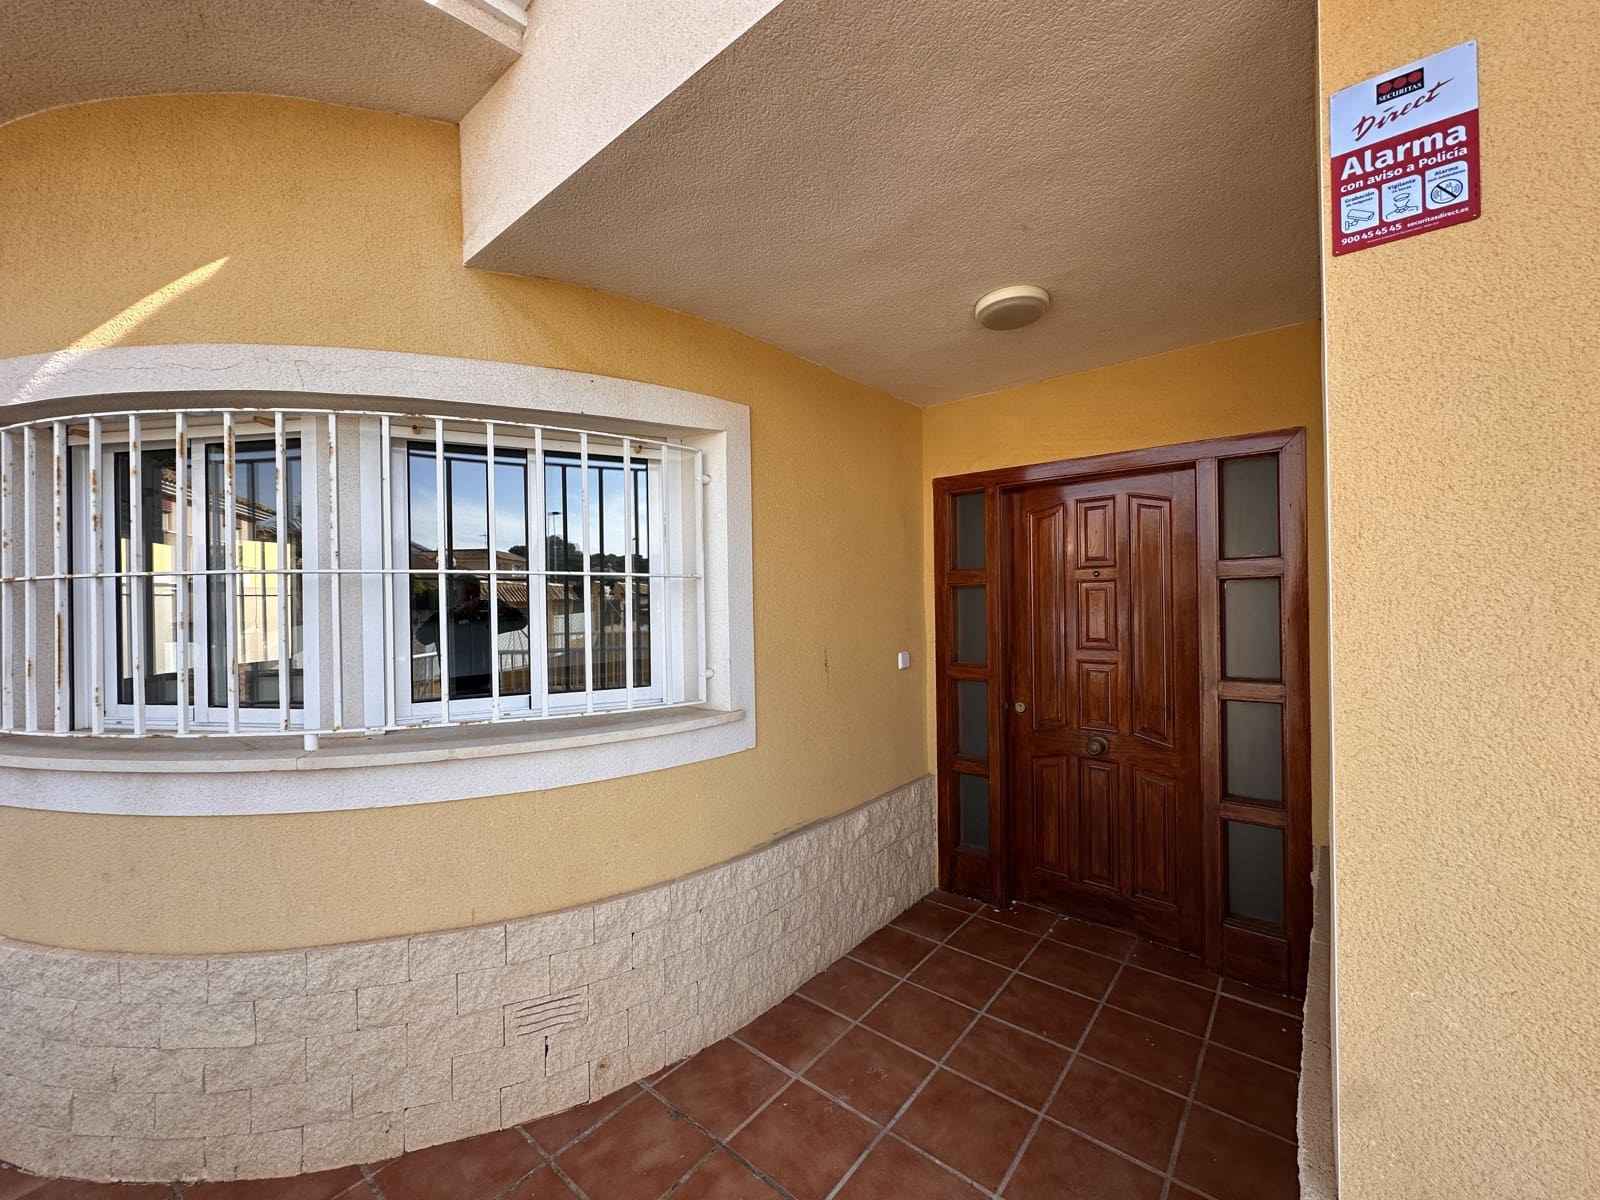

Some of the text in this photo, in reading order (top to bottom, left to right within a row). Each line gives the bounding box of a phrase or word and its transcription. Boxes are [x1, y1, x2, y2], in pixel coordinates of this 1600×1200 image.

[1352, 77, 1455, 142] Direct
[1378, 82, 1423, 102] SECURITAS
[1340, 125, 1468, 181] Alarma
[1340, 146, 1468, 193] con aviso a Policía
[1387, 179, 1416, 190] Vigilante
[1341, 234, 1360, 246] 900
[1361, 230, 1374, 240] 45
[1375, 227, 1388, 236] 45
[1389, 222, 1402, 231] 45
[1407, 207, 1469, 228] securitasdirect.es
